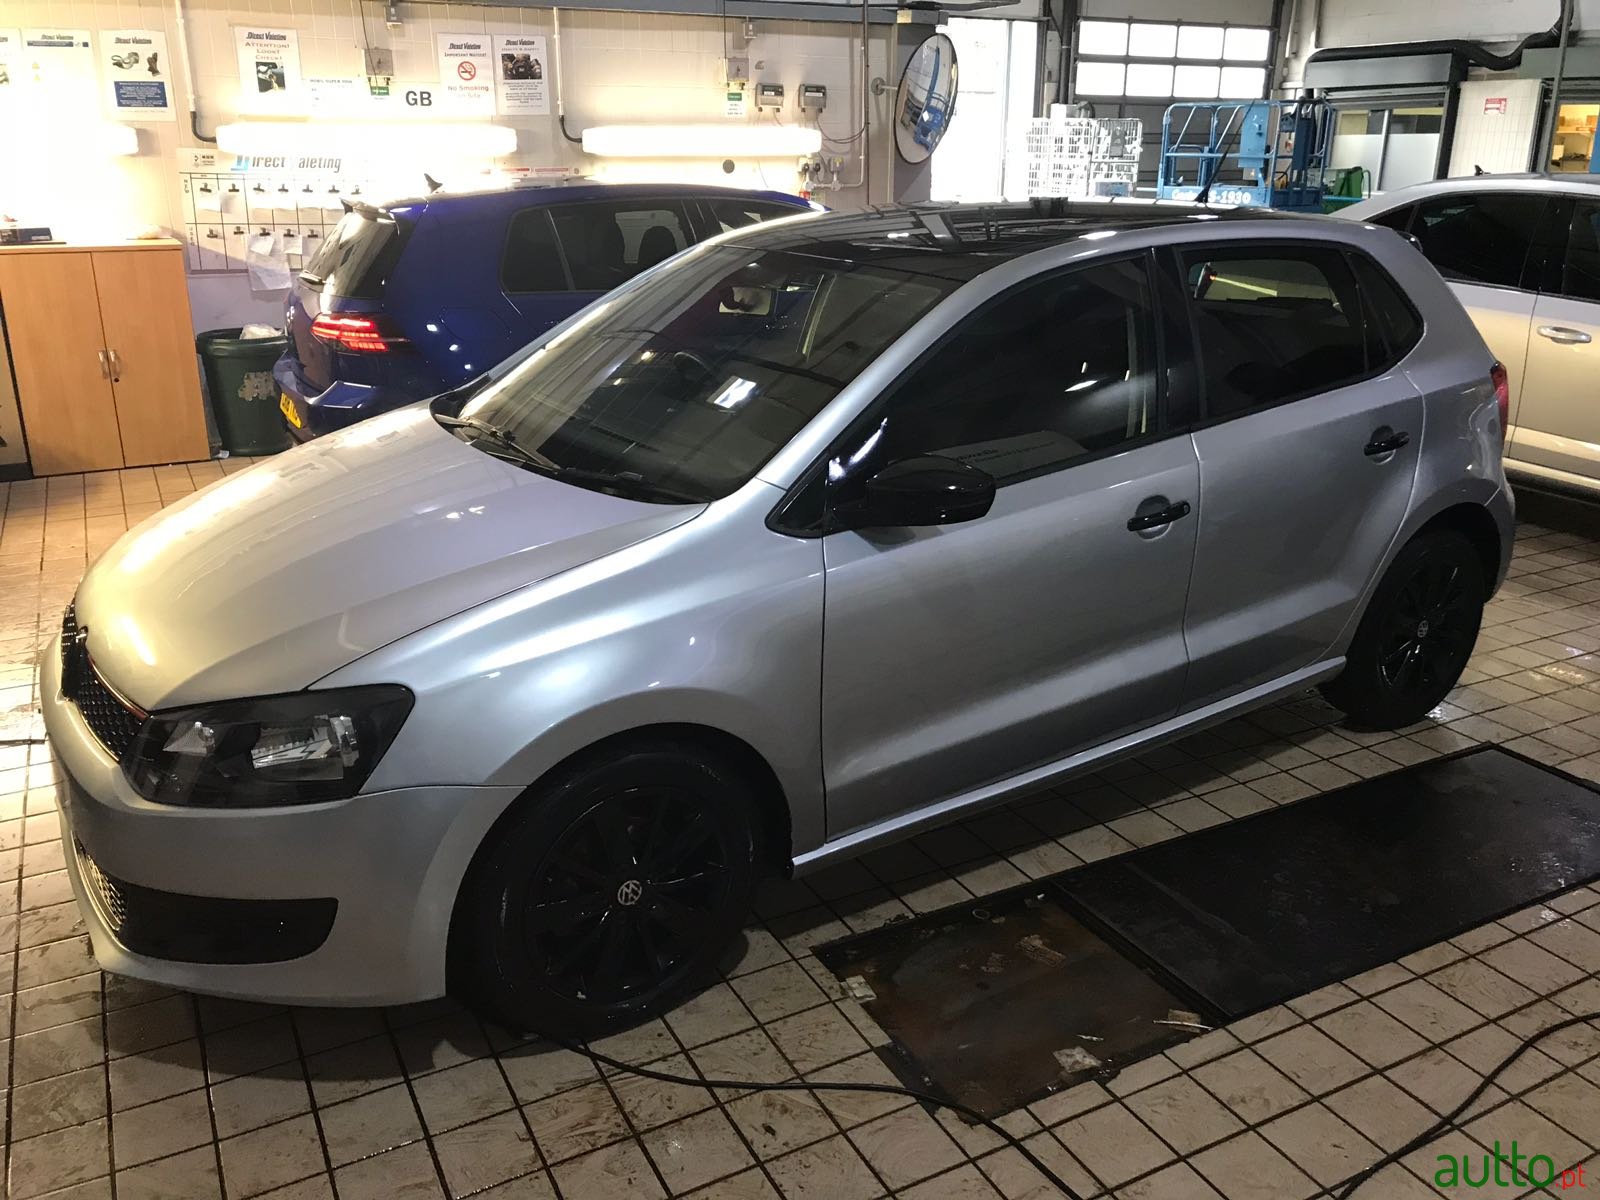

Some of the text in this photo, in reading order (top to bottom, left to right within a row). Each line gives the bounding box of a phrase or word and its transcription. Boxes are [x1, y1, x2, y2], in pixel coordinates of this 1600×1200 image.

[405, 90, 432, 106] GB
[297, 157, 342, 173] aleting
[1207, 190, 1252, 204] S-1930
